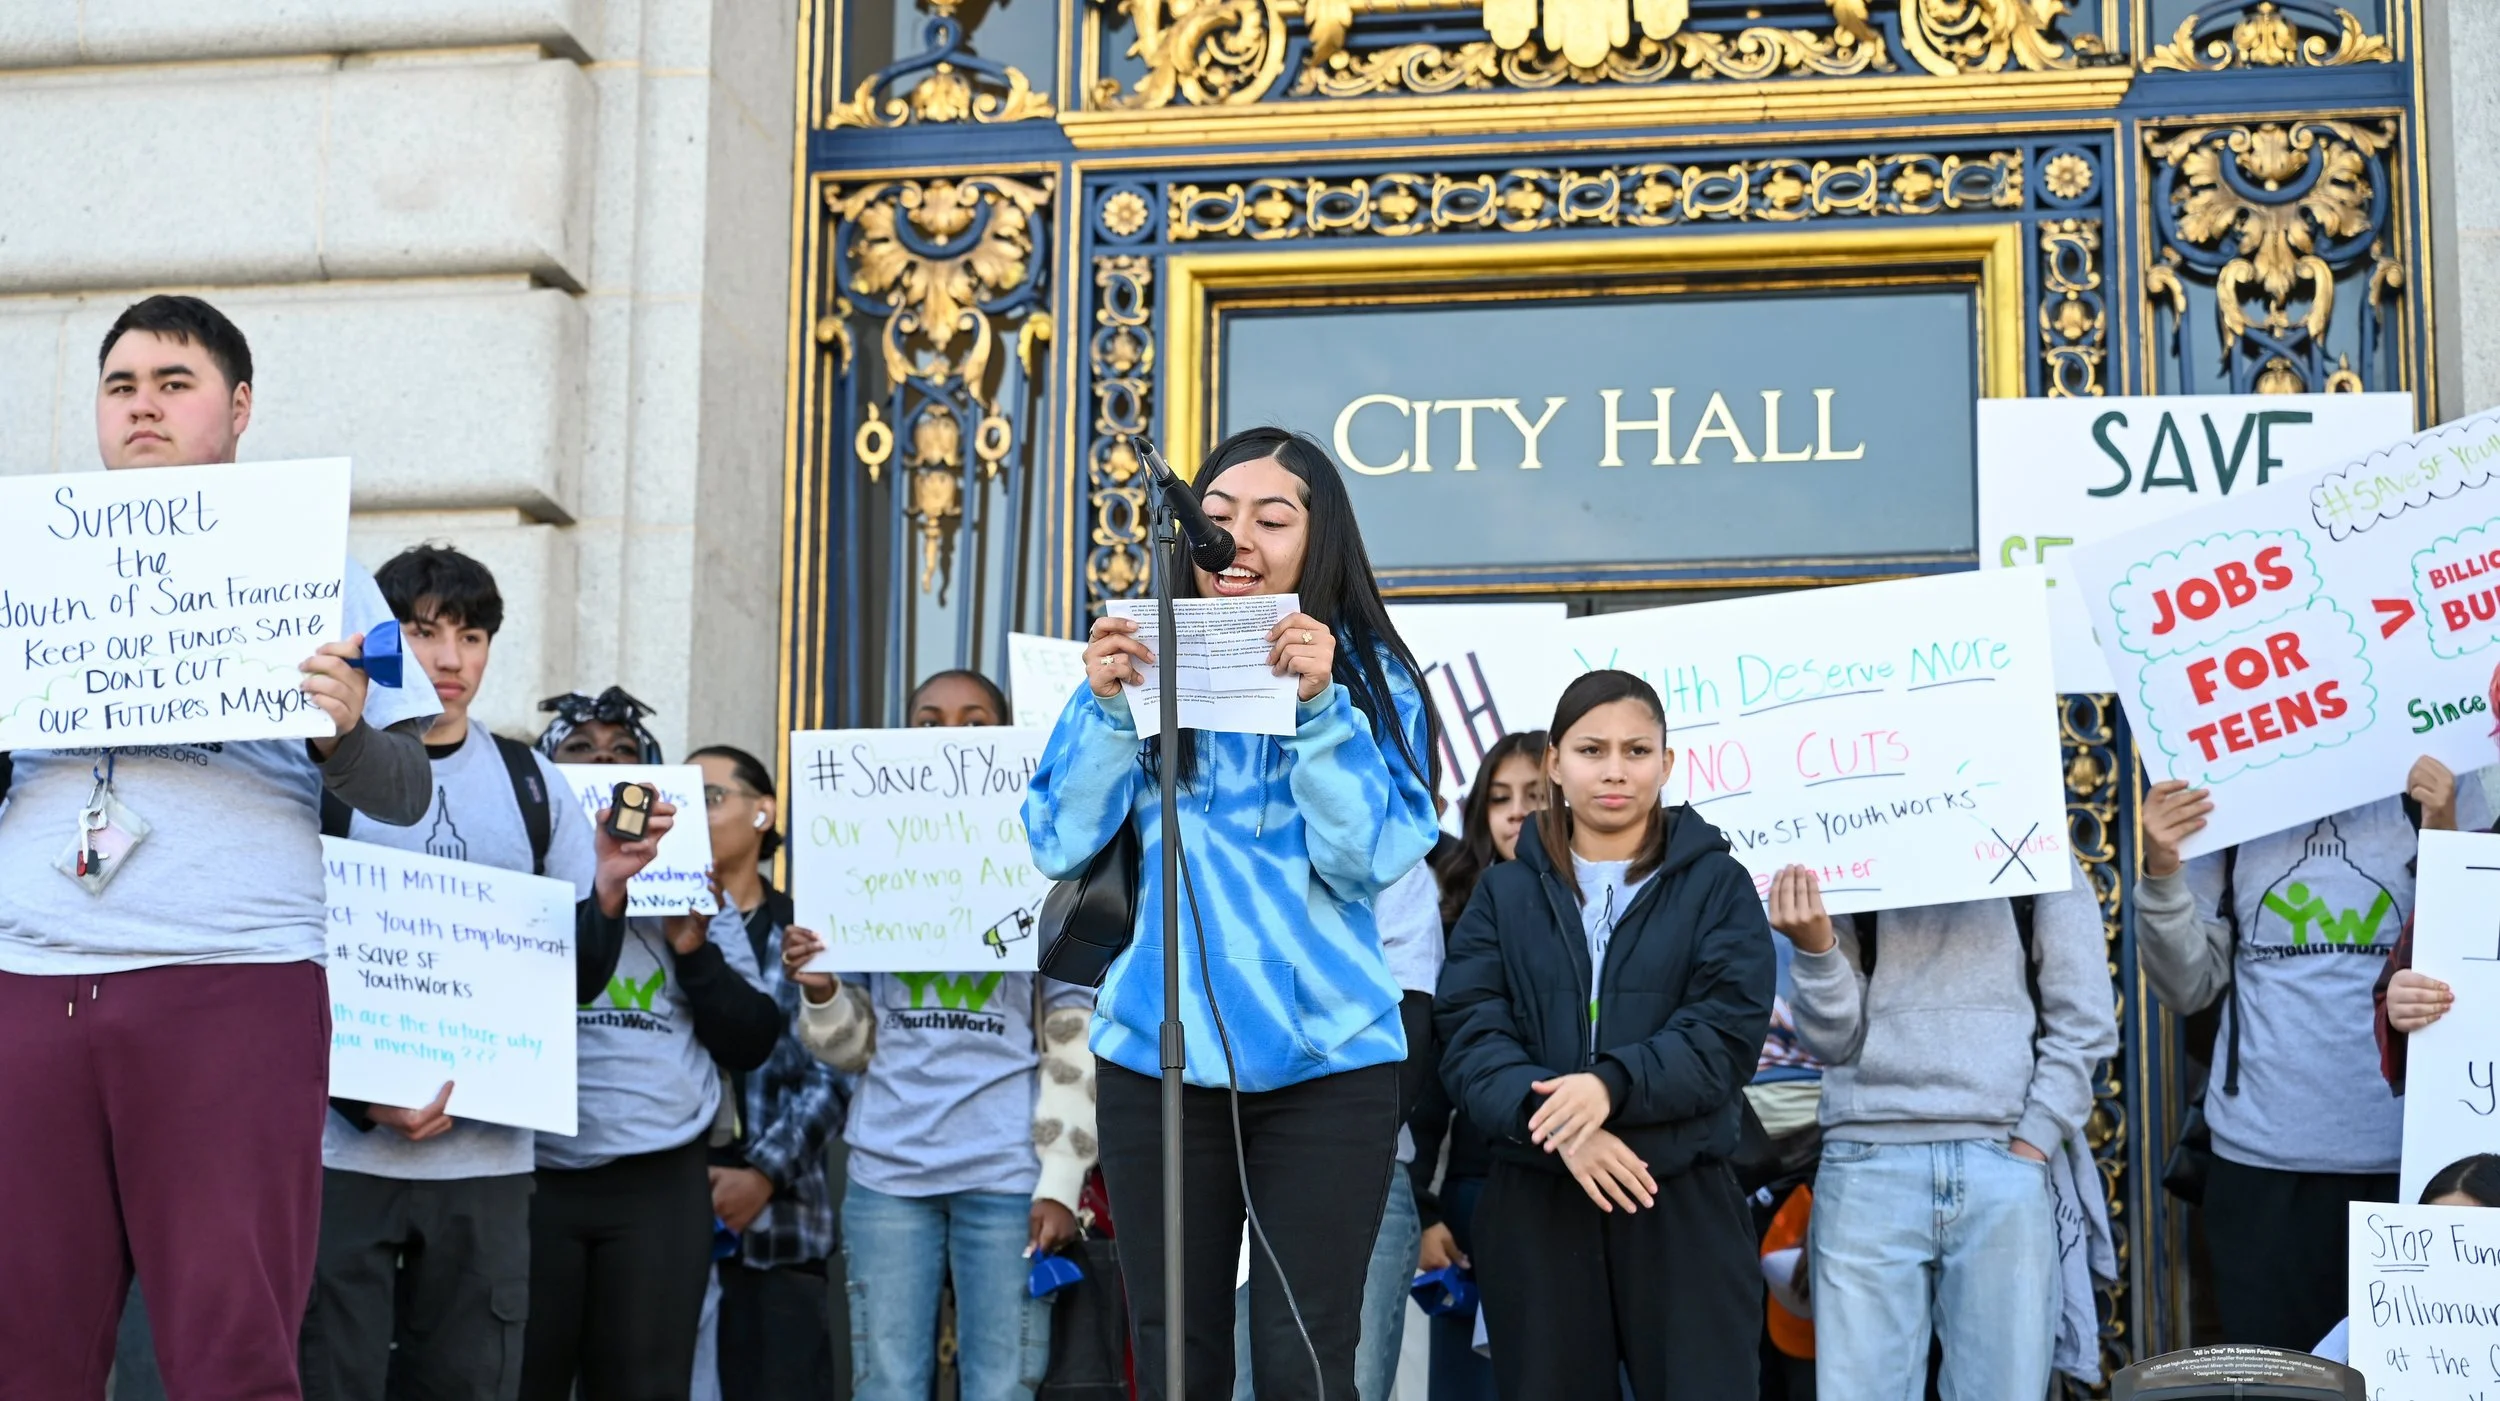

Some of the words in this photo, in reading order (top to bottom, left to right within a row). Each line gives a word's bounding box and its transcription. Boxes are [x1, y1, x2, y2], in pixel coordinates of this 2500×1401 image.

[1333, 393, 1568, 476] CITY
[1598, 387, 1866, 468] HALL
[107, 547, 171, 579] the
[109, 584, 140, 618] of
[151, 577, 218, 616] San
[2151, 546, 2294, 636] JOBS
[2441, 584, 2500, 633] BU
[107, 636, 154, 661] OUR
[168, 625, 249, 655] FUNDS
[175, 657, 231, 686] CUT
[1737, 653, 1895, 706] Deserve
[1910, 638, 2012, 684] More
[2185, 630, 2310, 707] FOR
[38, 707, 92, 735] OUR
[2187, 680, 2348, 764] TEENS
[2407, 694, 2488, 735] Since
[1687, 739, 1752, 801] NO
[1796, 730, 1910, 779] CUTS
[887, 810, 980, 858] youth
[328, 859, 387, 892] UTH
[402, 869, 496, 904] MATTER
[979, 857, 1031, 888] Are
[375, 910, 444, 940] Youth
[452, 923, 571, 958] Employment
[358, 968, 474, 999] YouthWorks
[2367, 1213, 2433, 1263] STOP
[2450, 1224, 2500, 1267] Fun
[2386, 1346, 2411, 1373] at
[2426, 1345, 2470, 1378] the
